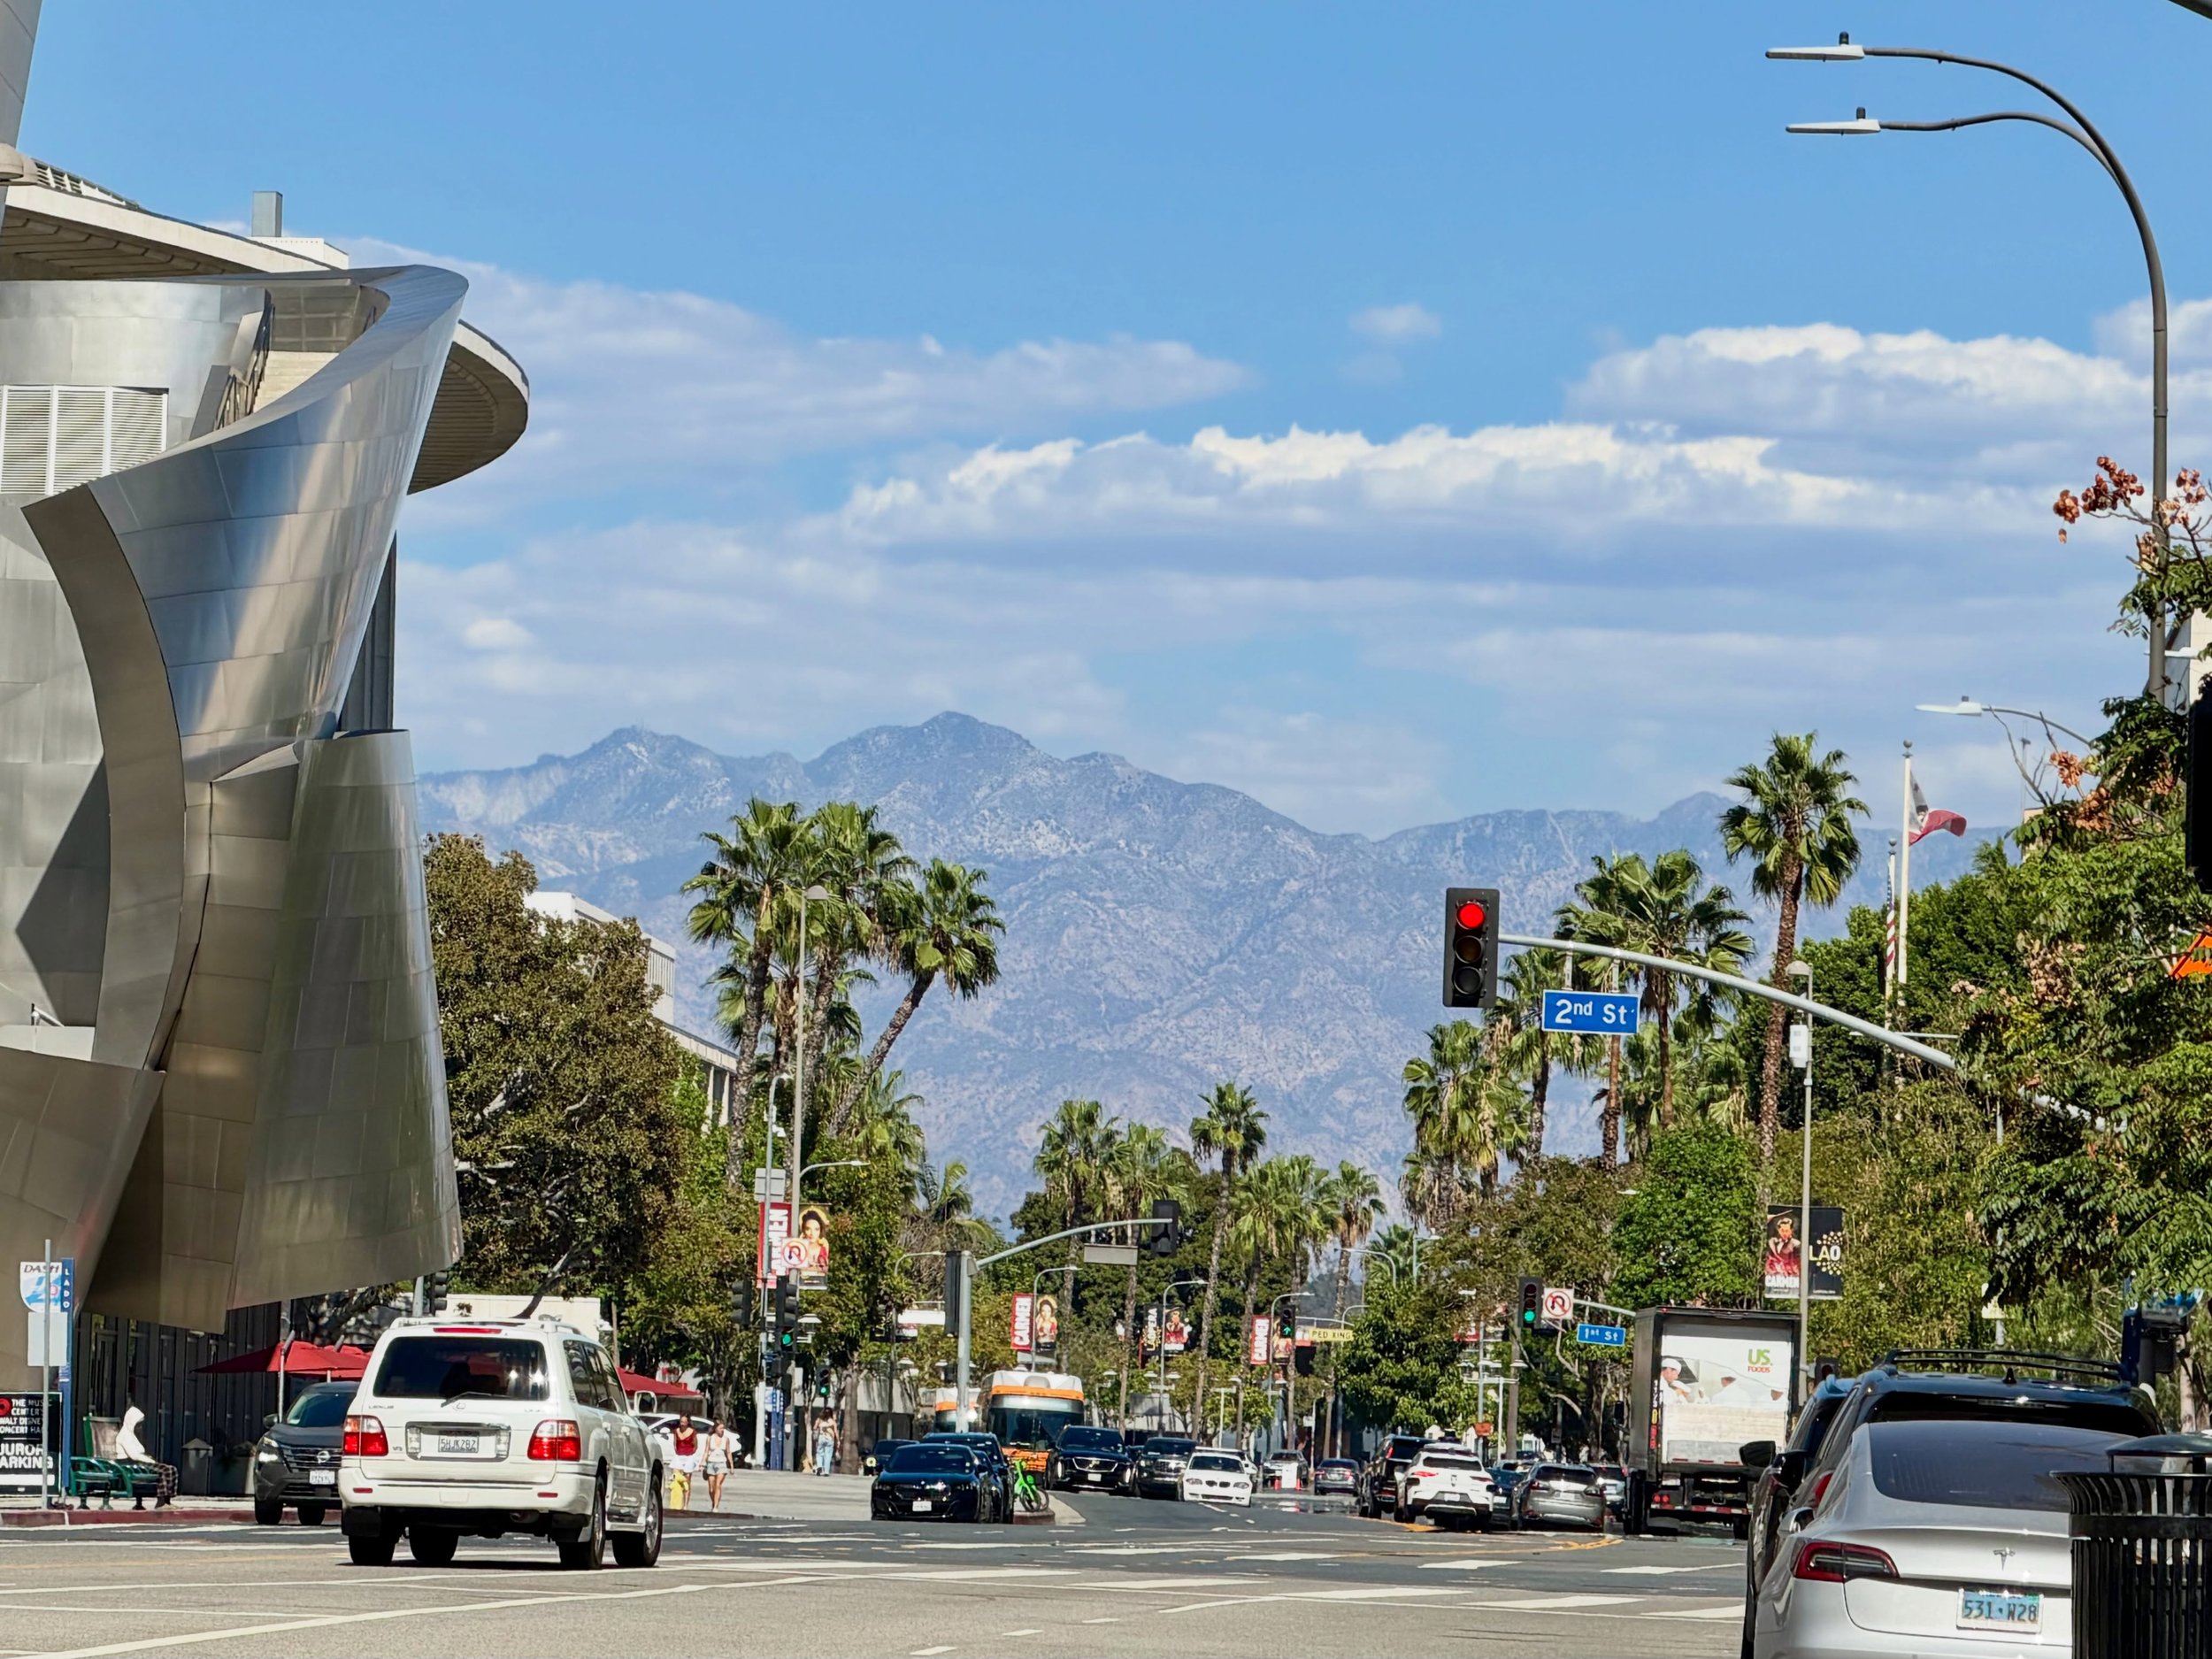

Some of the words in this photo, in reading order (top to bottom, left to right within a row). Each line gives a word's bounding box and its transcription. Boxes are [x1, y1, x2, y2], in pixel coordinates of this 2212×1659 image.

[1555, 999, 1593, 1024] 2nd
[1602, 1003, 1627, 1025] St
[1809, 1245, 1840, 1261] LAO
[1765, 1275, 1800, 1287] CARMEN
[1014, 1297, 1032, 1345] CARMEN
[1312, 1330, 1327, 1339] PED
[1585, 1328, 1599, 1339] 1st
[1604, 1331, 1618, 1341] St
[1747, 1348, 1770, 1365] US
